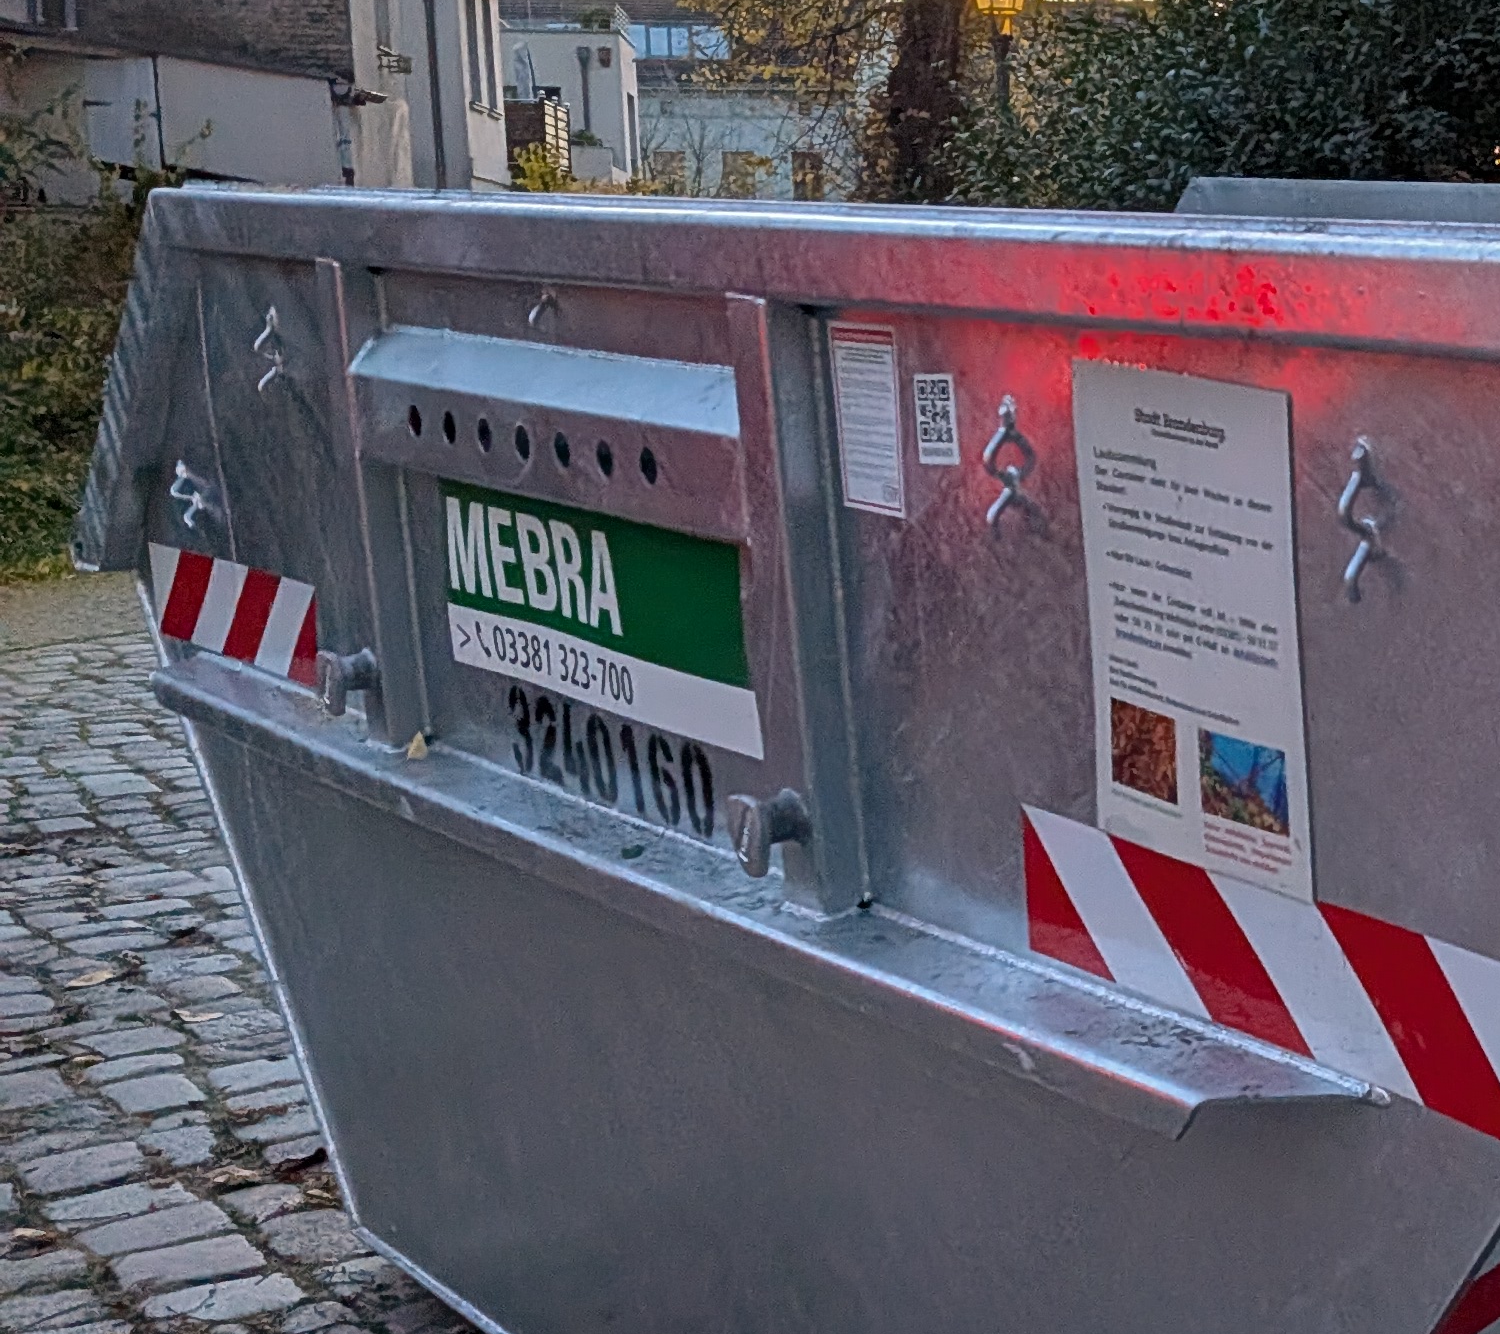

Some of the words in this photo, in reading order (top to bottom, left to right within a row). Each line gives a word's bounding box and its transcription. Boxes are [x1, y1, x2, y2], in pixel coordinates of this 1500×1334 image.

[446, 495, 624, 637] MEBRA
[492, 628, 552, 677] 03381
[558, 643, 635, 705] 323-700
[507, 684, 714, 838] 3240160
